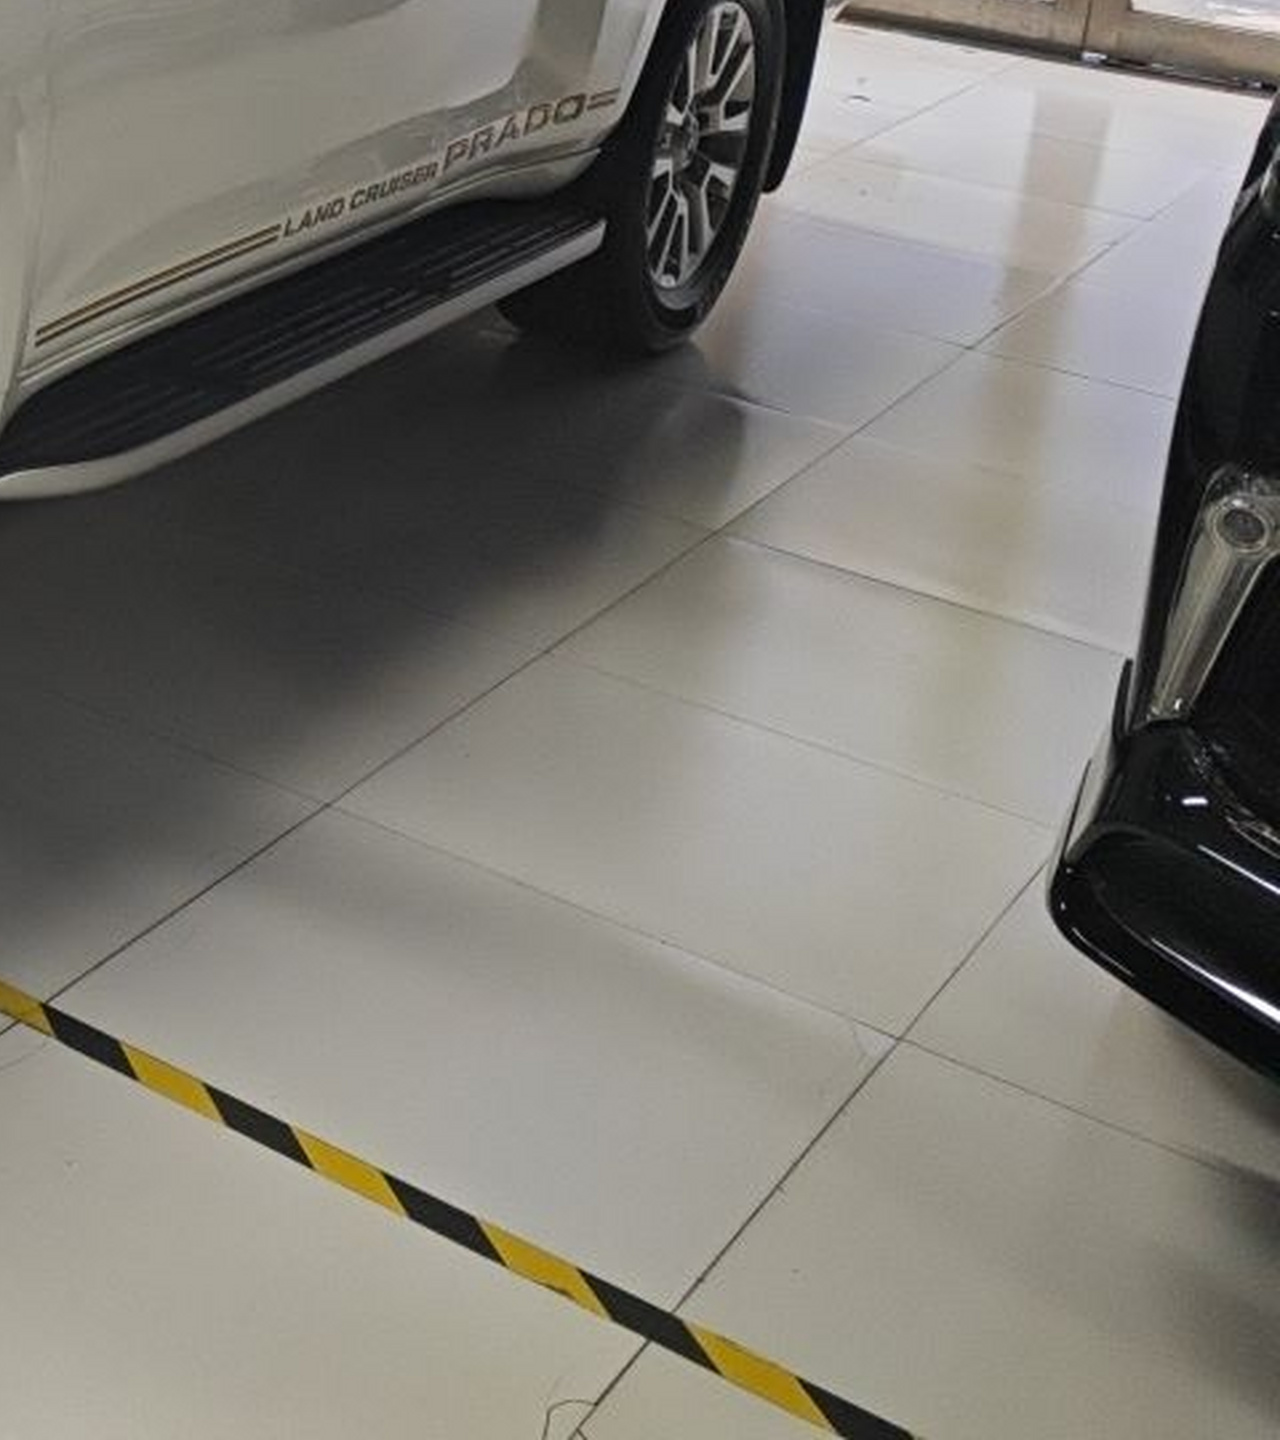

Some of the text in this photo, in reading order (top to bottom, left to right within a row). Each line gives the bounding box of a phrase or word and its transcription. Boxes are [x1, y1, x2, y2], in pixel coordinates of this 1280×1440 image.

[283, 94, 587, 237] LAND CRUISER PRADO
